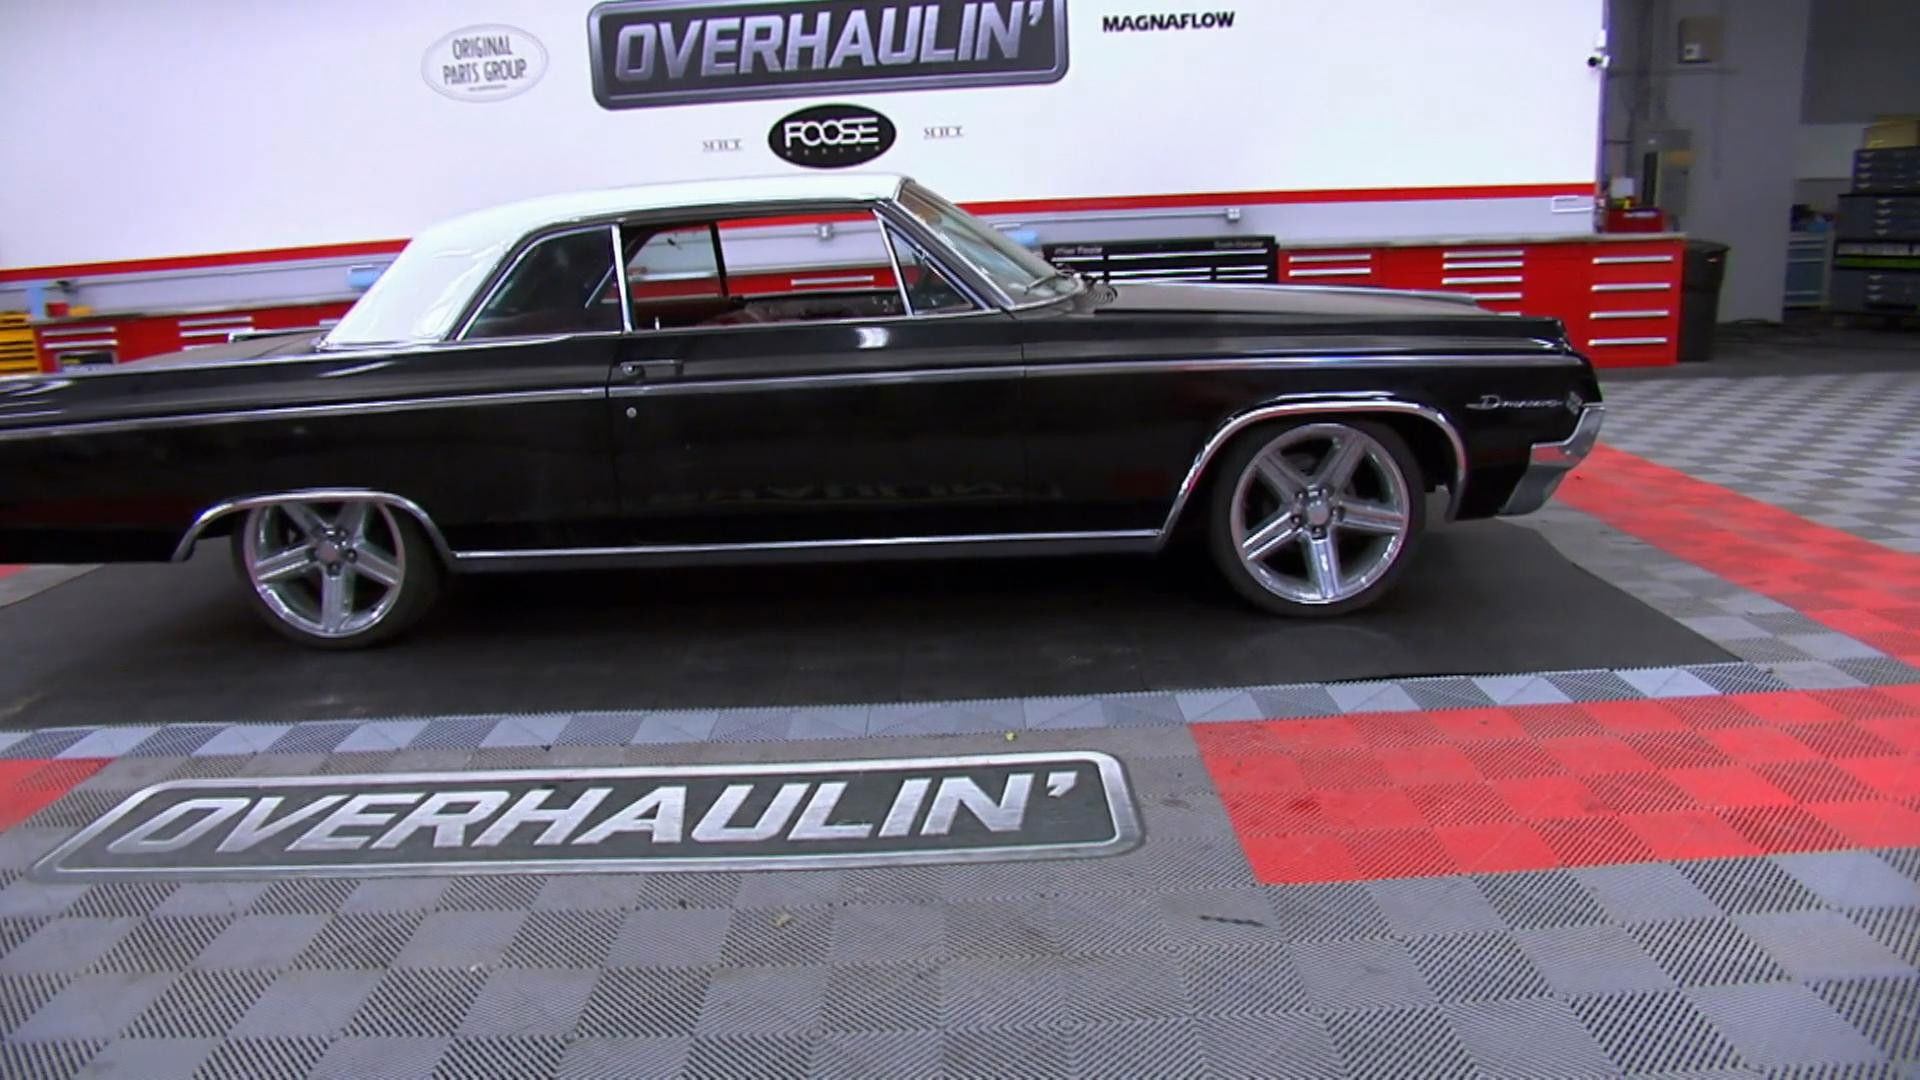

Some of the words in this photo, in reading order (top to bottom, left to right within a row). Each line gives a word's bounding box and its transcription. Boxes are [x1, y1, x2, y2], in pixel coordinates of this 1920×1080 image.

[1102, 11, 1235, 32] MAGNAFLOW
[452, 35, 513, 60] ORIGINAL
[443, 62, 479, 85] PARTS
[483, 58, 527, 82] GROUP
[784, 117, 880, 148] FOOSE
